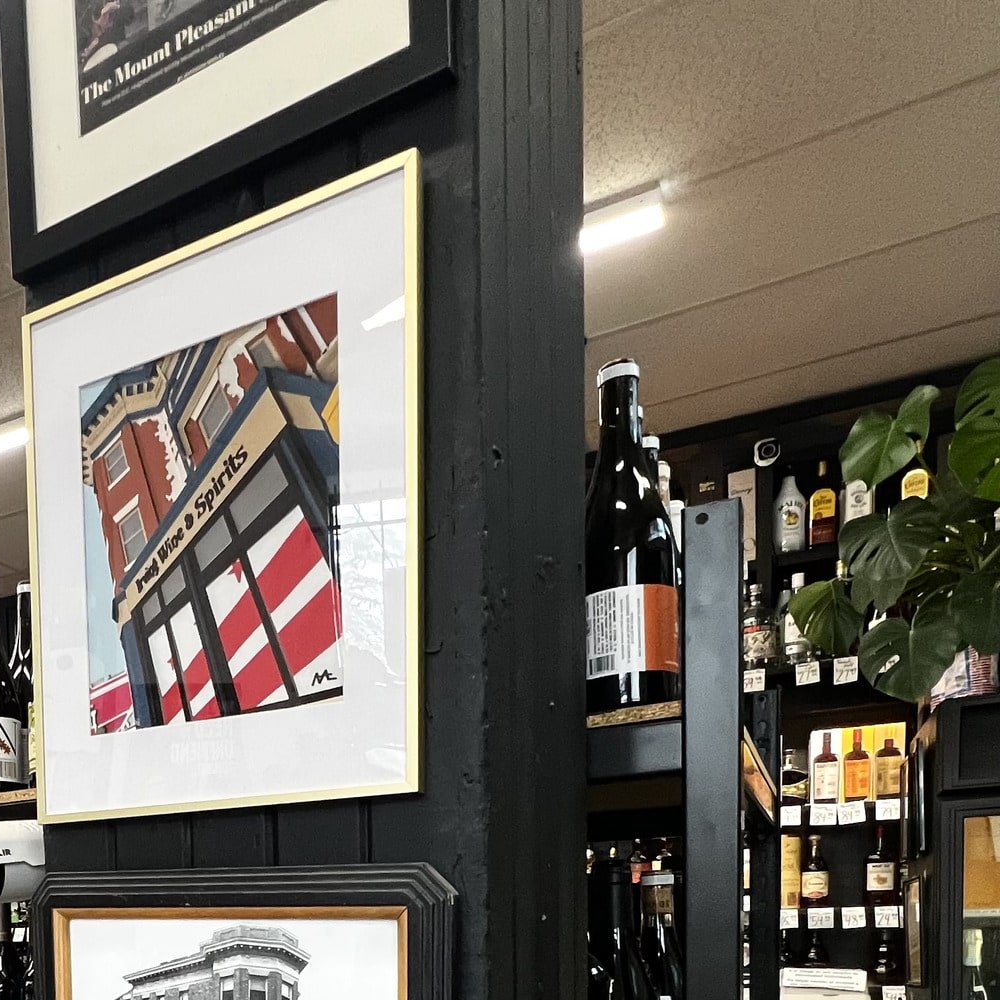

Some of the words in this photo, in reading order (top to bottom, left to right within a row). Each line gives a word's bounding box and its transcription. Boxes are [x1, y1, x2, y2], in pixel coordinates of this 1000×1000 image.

[81, 78, 112, 104] The
[114, 41, 171, 87] Mount
[157, 527, 185, 564] Wine
[194, 445, 248, 519] Spirits
